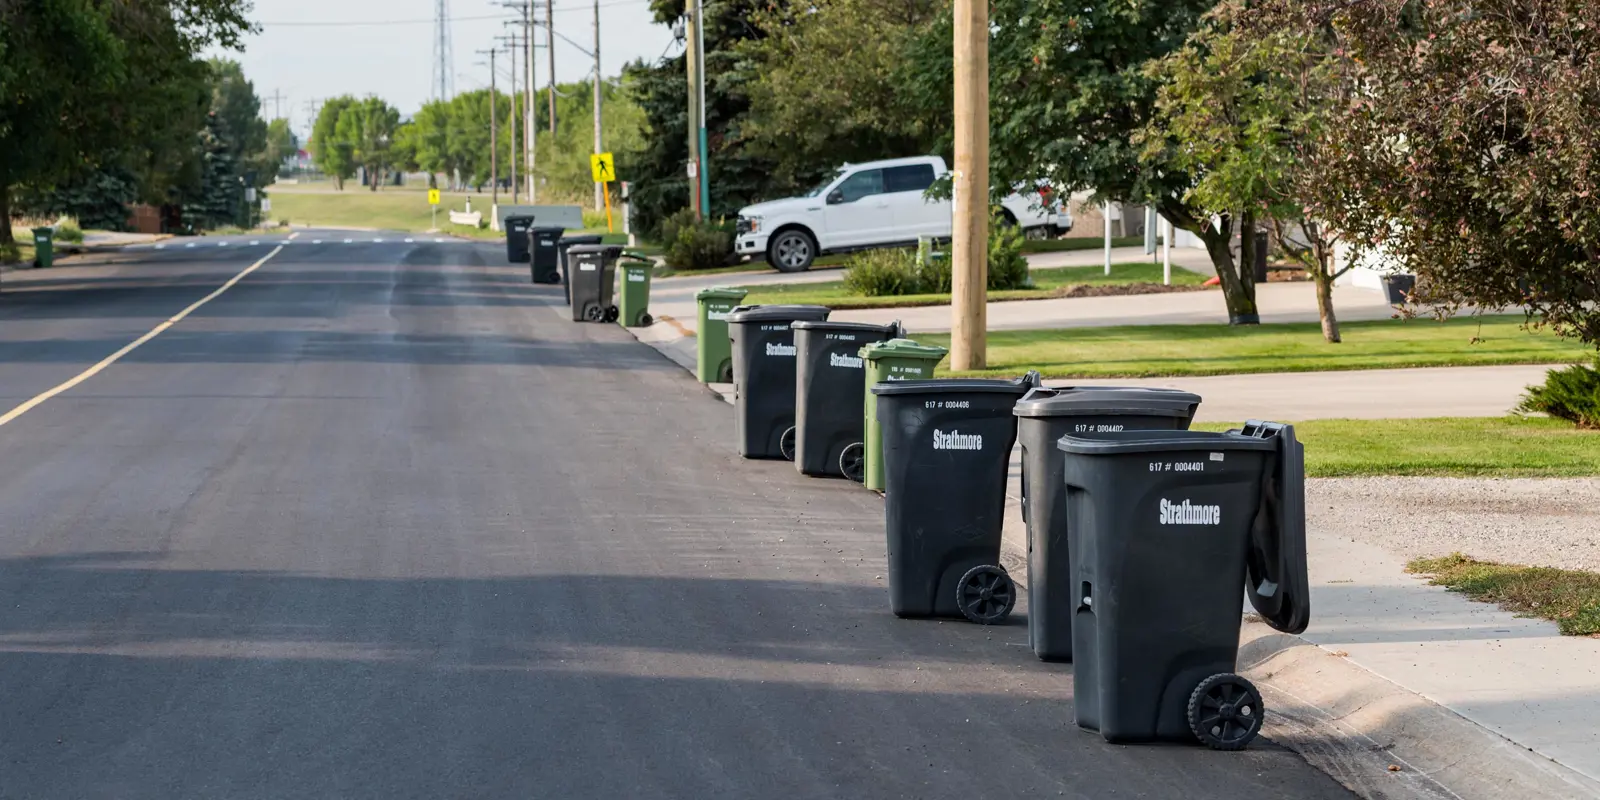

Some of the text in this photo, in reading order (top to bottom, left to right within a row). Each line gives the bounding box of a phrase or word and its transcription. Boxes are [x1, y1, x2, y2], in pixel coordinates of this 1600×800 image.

[766, 342, 796, 356] Strathmore
[830, 352, 862, 368] Strathmore
[925, 401, 936, 409] 617
[945, 401, 970, 409] 0004406
[1075, 424, 1124, 432] 617 # 0004402
[933, 428, 982, 450] Strathmore
[1149, 462, 1204, 471] 617 # 0004401
[1159, 498, 1220, 525] Strathmore
